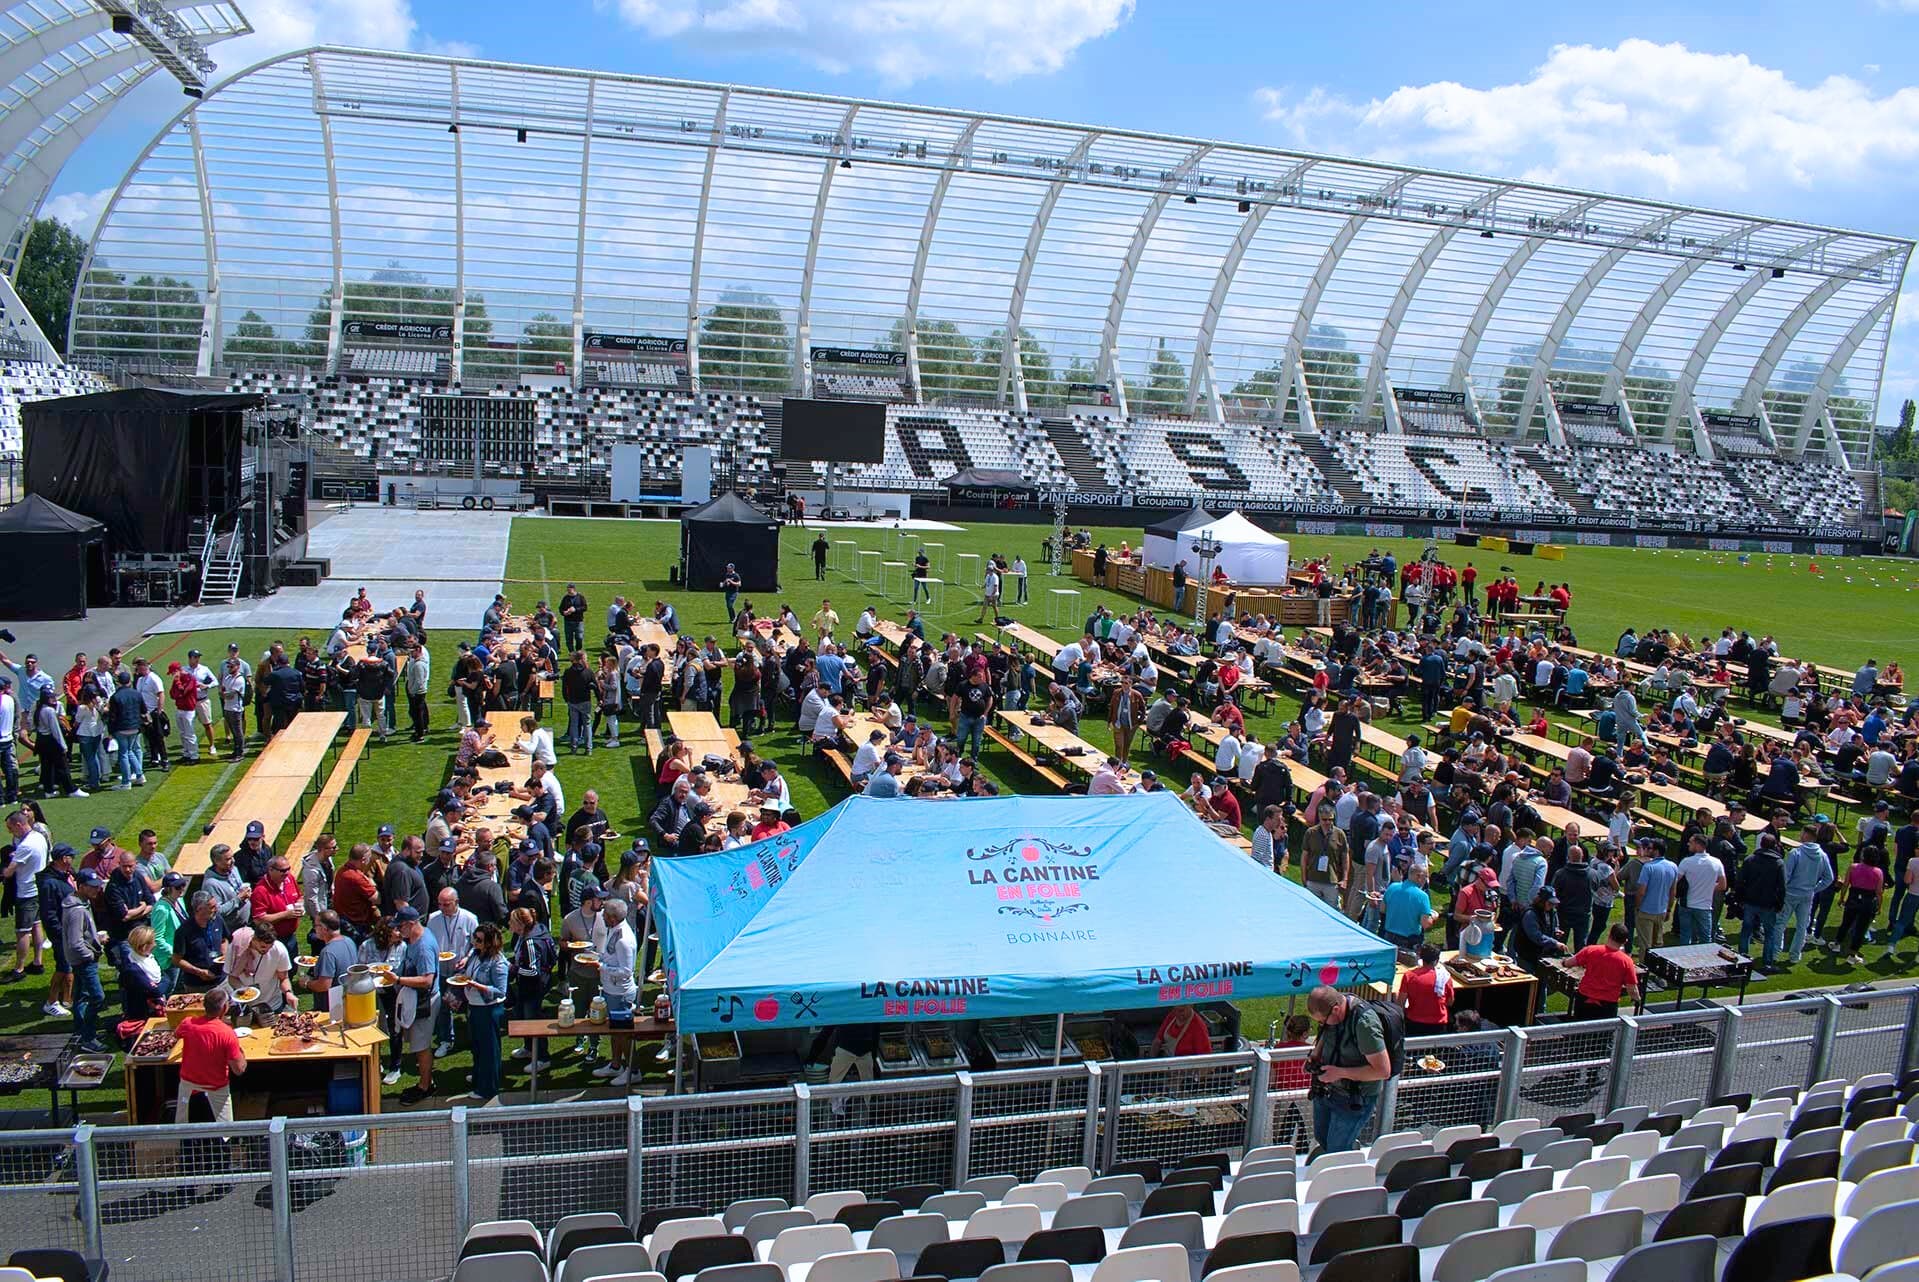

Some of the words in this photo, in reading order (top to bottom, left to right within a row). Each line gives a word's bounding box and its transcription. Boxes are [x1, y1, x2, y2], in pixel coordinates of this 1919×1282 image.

[375, 323, 397, 331] CRÉDIT
[399, 324, 431, 332] AGRICOLE
[202, 330, 209, 338] A
[615, 337, 636, 345] CRÉDIT
[895, 416, 974, 478] A
[1165, 431, 1251, 490] S
[1404, 446, 1492, 502] C
[966, 490, 1002, 499] Courrier
[1003, 491, 1030, 502] pcard
[1049, 492, 1121, 505] INTERSPORT
[1137, 496, 1189, 507] Groupama
[1217, 500, 1243, 509] CRÉDIT
[1244, 502, 1282, 510] AGRICOLE
[1293, 503, 1356, 514] INTERSPORT
[1578, 517, 1598, 525] CRÉDIT
[1815, 528, 1861, 538] INTERSPORT
[968, 869, 997, 884] LA
[1003, 865, 1100, 882] CANTINE
[996, 885, 1023, 900] EN
[1026, 882, 1081, 898] FOLIE
[1006, 929, 1096, 944] BONNAIRE
[1136, 967, 1162, 984] LA
[1167, 961, 1253, 983] CANTINE
[860, 981, 888, 998] LA
[895, 978, 989, 996] CANTINE
[1159, 985, 1181, 1000] EN
[1186, 980, 1233, 998] FOLIE
[884, 1000, 908, 1015] EN
[913, 998, 967, 1015] FOLIE
